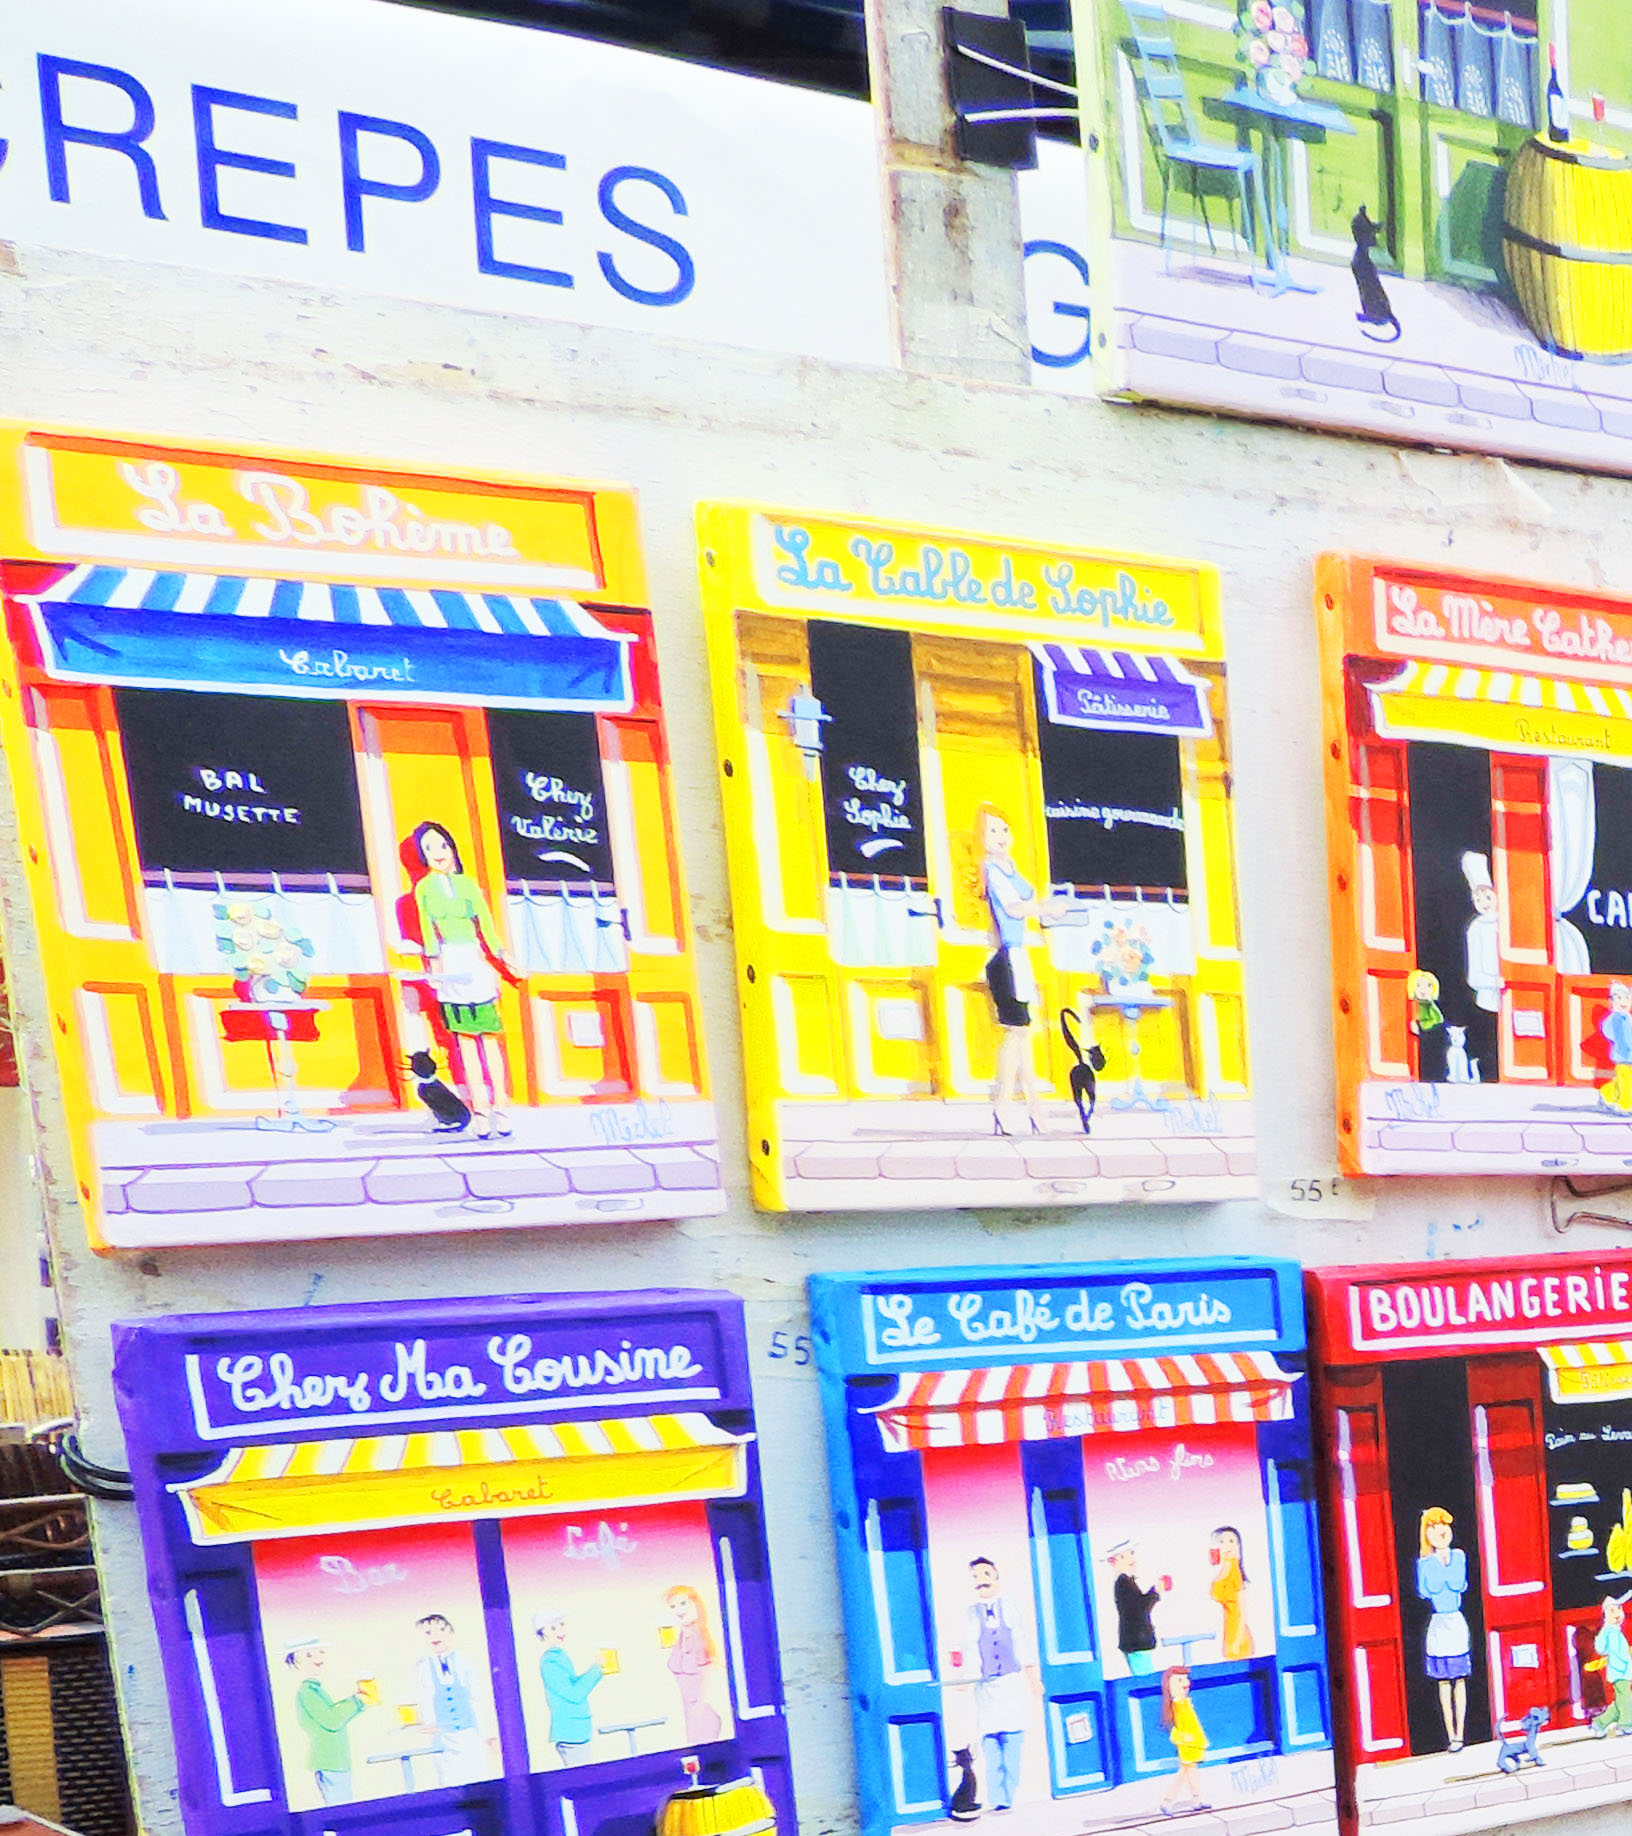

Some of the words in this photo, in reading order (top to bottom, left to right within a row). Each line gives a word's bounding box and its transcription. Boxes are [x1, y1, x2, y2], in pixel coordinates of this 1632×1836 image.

[0, 50, 697, 308] REPES
[122, 459, 233, 535] La
[241, 469, 522, 560] Bohème
[774, 524, 852, 590] La
[852, 537, 988, 603] Table
[989, 556, 1038, 610] de
[1043, 562, 1175, 629] Sophie
[1388, 583, 1446, 639] La
[280, 648, 416, 684] Cabaret
[182, 795, 300, 824] MUSETTE
[198, 766, 265, 794] BAL
[875, 1293, 942, 1347] Le
[947, 1288, 1060, 1342] Café
[1064, 1288, 1116, 1332] de
[1119, 1281, 1233, 1330] Paris
[215, 1351, 372, 1412] Chez
[378, 1337, 488, 1402] Ma
[486, 1334, 705, 1395] Cousine
[430, 1474, 555, 1511] Cabaret
